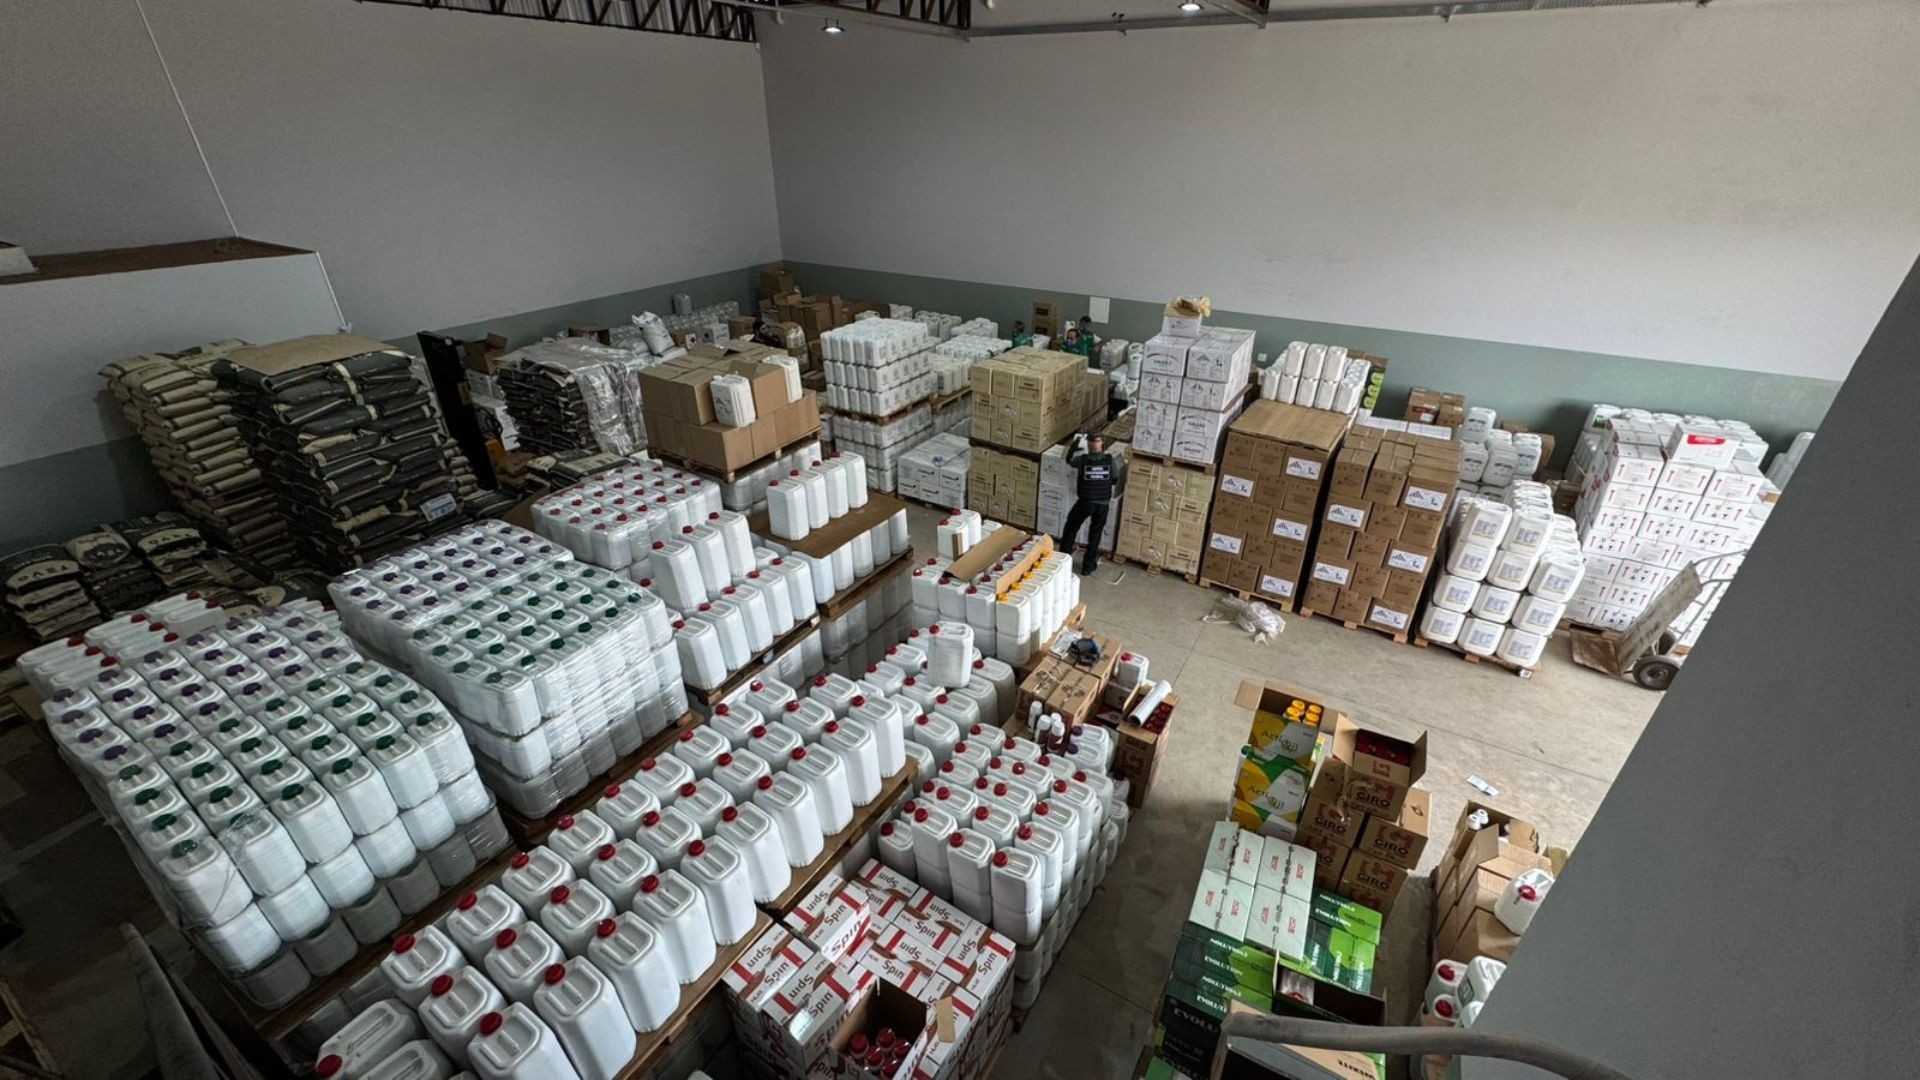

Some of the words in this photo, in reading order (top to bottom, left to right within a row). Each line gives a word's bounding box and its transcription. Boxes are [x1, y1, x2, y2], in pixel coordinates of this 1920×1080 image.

[1356, 791, 1390, 808] GIRO
[1315, 816, 1346, 834] GIRO
[1375, 838, 1409, 856] GIRO
[878, 872, 899, 889] Spin
[1358, 873, 1390, 890] GIRO
[806, 890, 829, 912] Spin
[929, 901, 951, 921] Spin
[824, 904, 847, 926] Spin
[914, 920, 937, 940] Spin
[900, 941, 922, 961] Spin
[956, 940, 977, 962] Spin
[882, 959, 905, 980] Spin
[978, 952, 998, 975] Spin
[788, 973, 814, 1000] Spin
